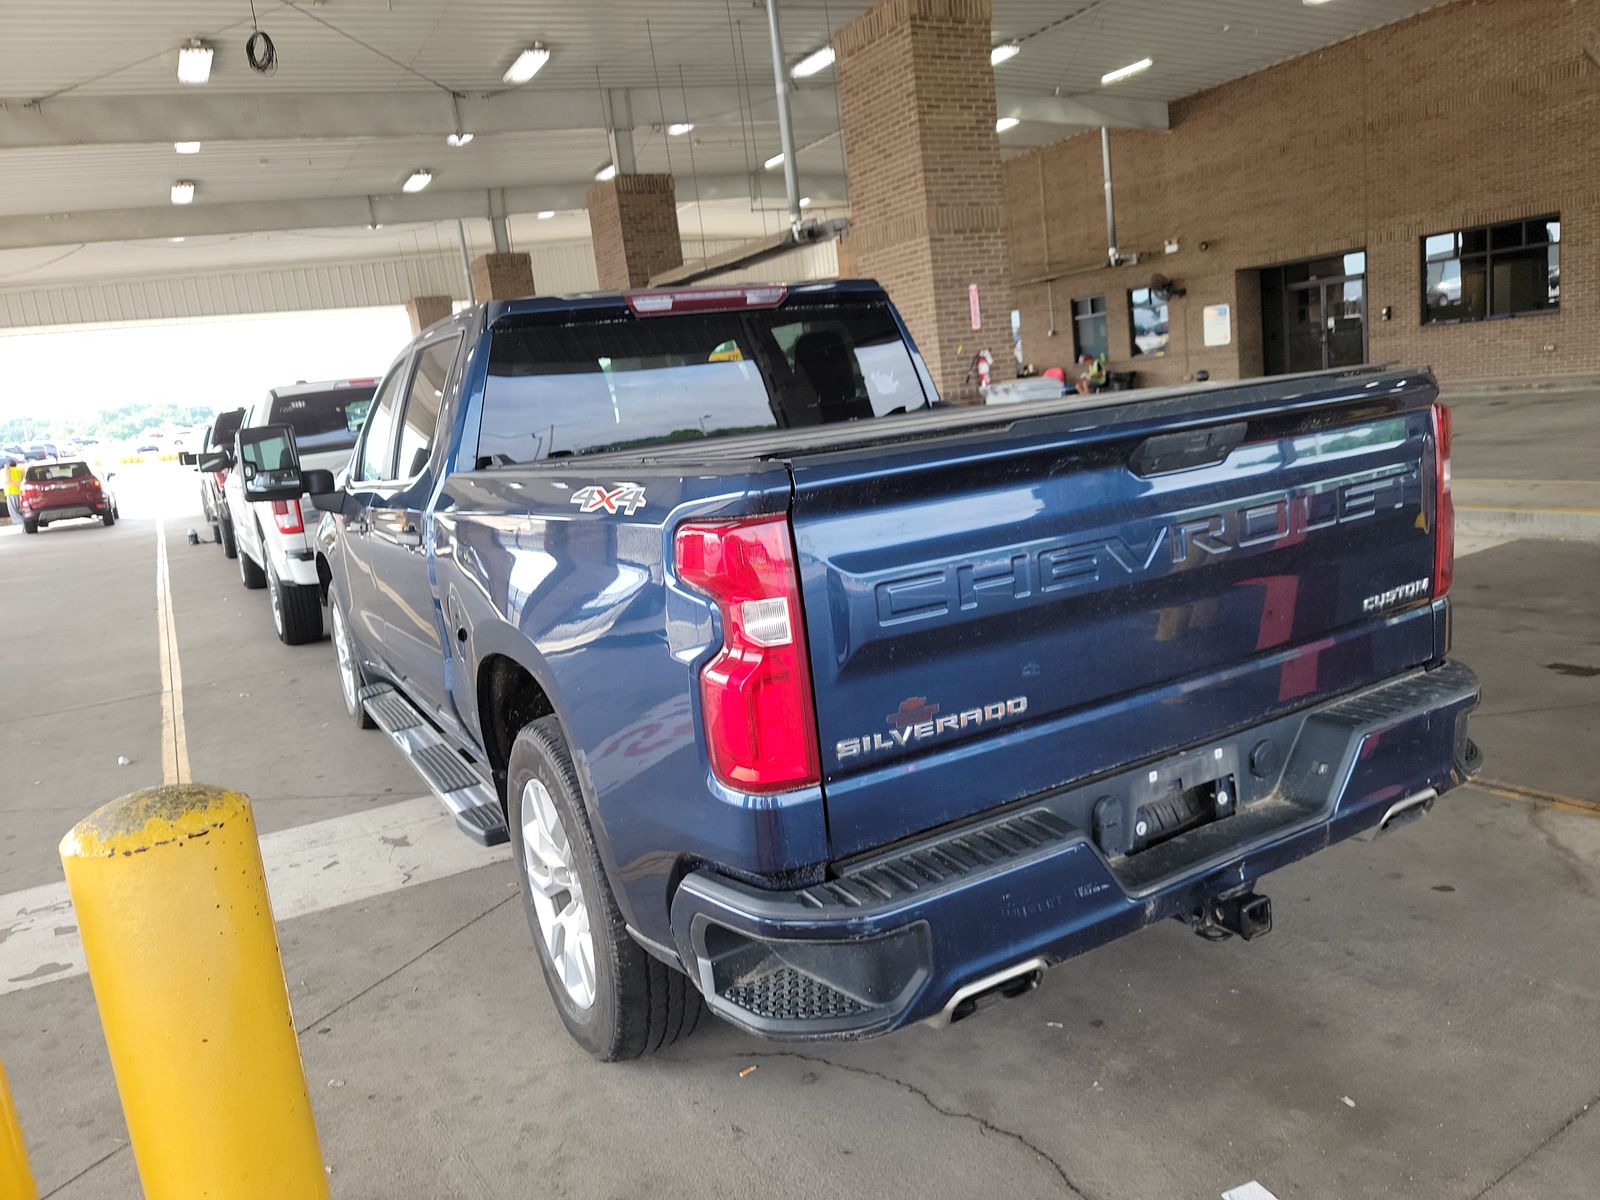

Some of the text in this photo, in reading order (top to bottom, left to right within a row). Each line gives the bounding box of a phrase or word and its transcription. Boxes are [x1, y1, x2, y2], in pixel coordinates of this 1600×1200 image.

[875, 471, 1417, 627] CHEVROLET
[1363, 577, 1429, 612] CUSTOM
[836, 696, 1028, 760] SILVERADO
